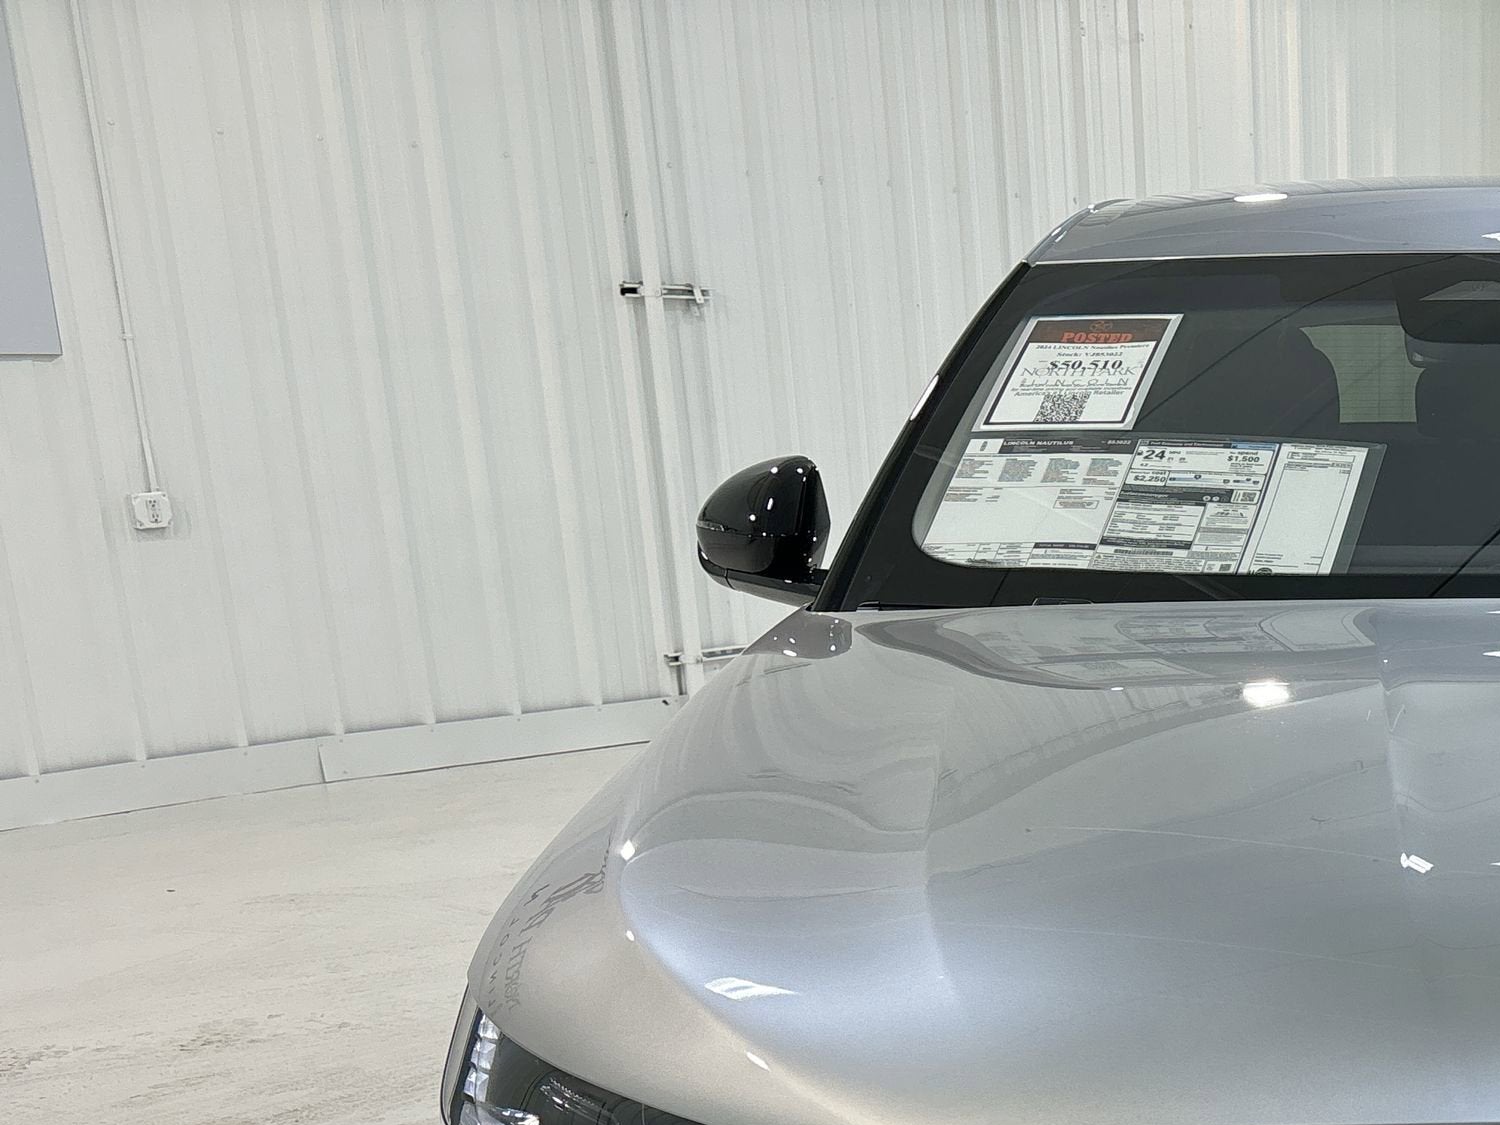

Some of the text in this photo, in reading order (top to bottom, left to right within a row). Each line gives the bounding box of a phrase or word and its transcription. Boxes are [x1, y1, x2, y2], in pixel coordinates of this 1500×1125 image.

[1061, 331, 1133, 344] POSTED
[1049, 359, 1123, 373] $50,510
[1143, 449, 1166, 460] 24
[1227, 455, 1260, 463] $1,500
